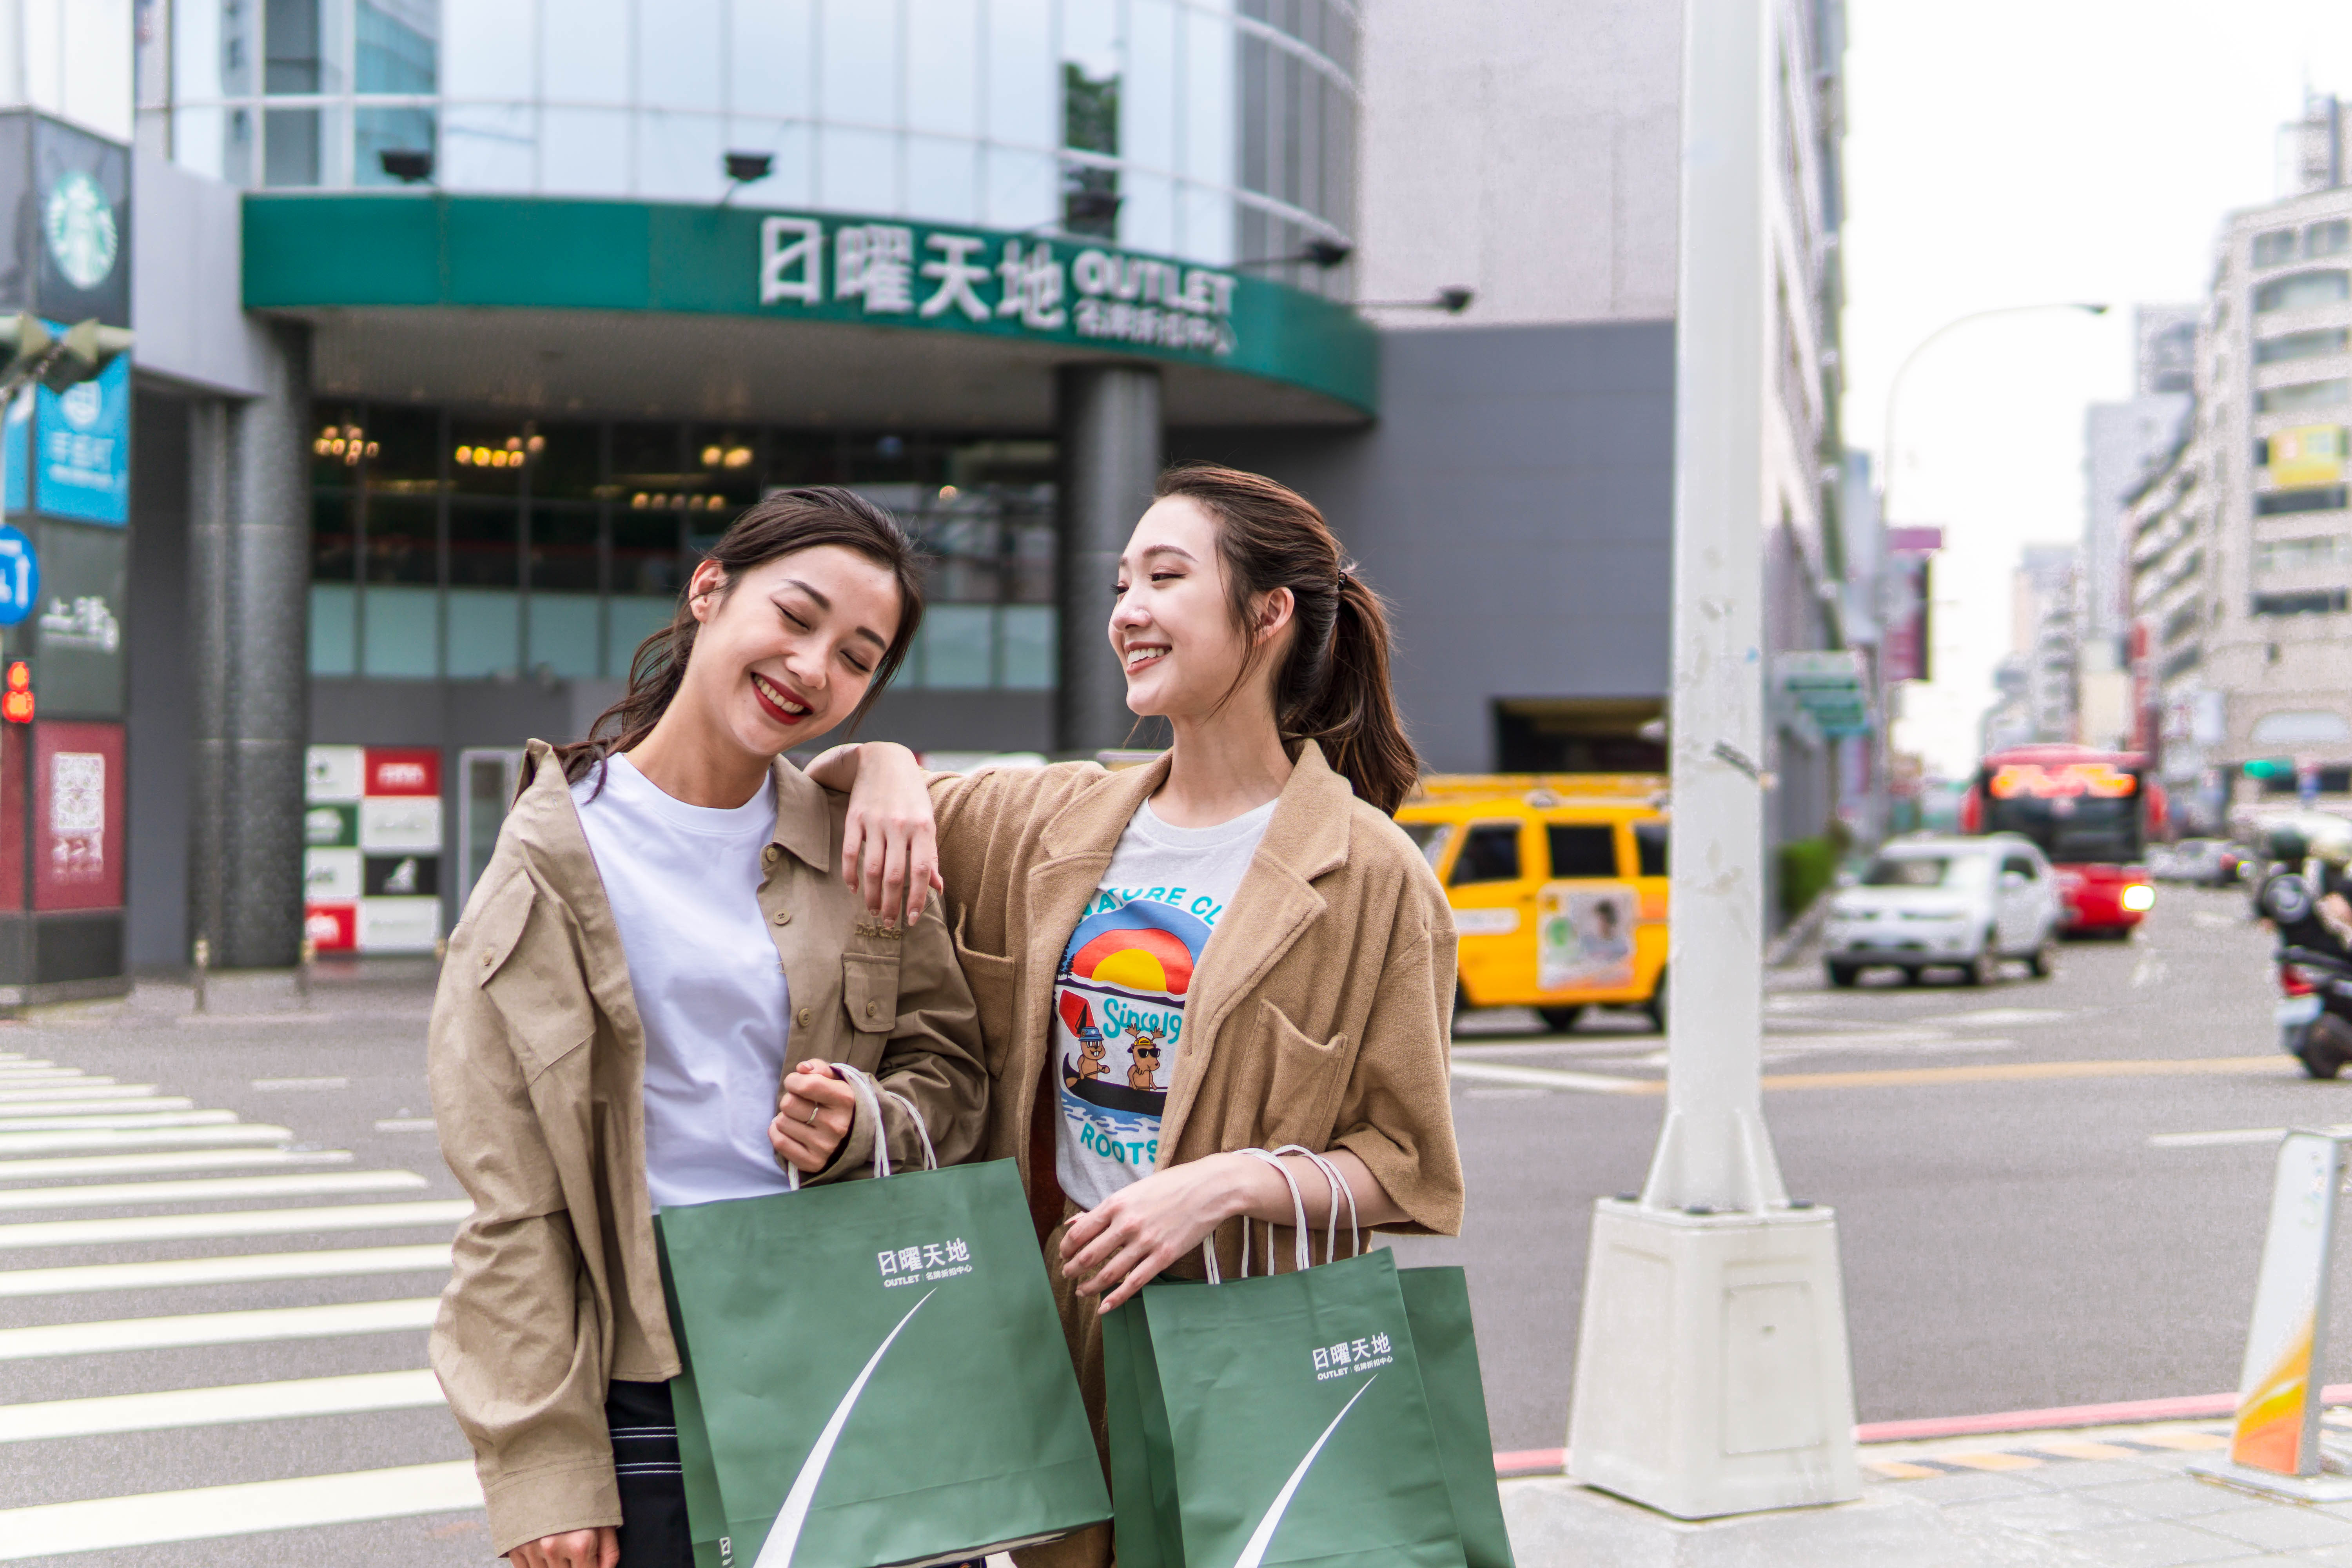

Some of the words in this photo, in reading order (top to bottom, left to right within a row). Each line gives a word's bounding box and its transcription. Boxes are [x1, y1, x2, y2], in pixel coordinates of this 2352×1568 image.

[759, 216, 1067, 329] 日曜天地
[1072, 249, 1238, 314] OUTLET
[1079, 887, 1187, 924] ATURE
[1103, 998, 1159, 1038] Since
[1163, 1012, 1182, 1044] 19
[1080, 1122, 1158, 1165] ROOTS
[878, 1237, 970, 1276] 日曜天地
[884, 1274, 920, 1287] OUTLET
[1312, 1332, 1391, 1371] 日曜天地
[1317, 1367, 1348, 1380] OUTLET
[1354, 1355, 1393, 1372] 名牌折扣中心
